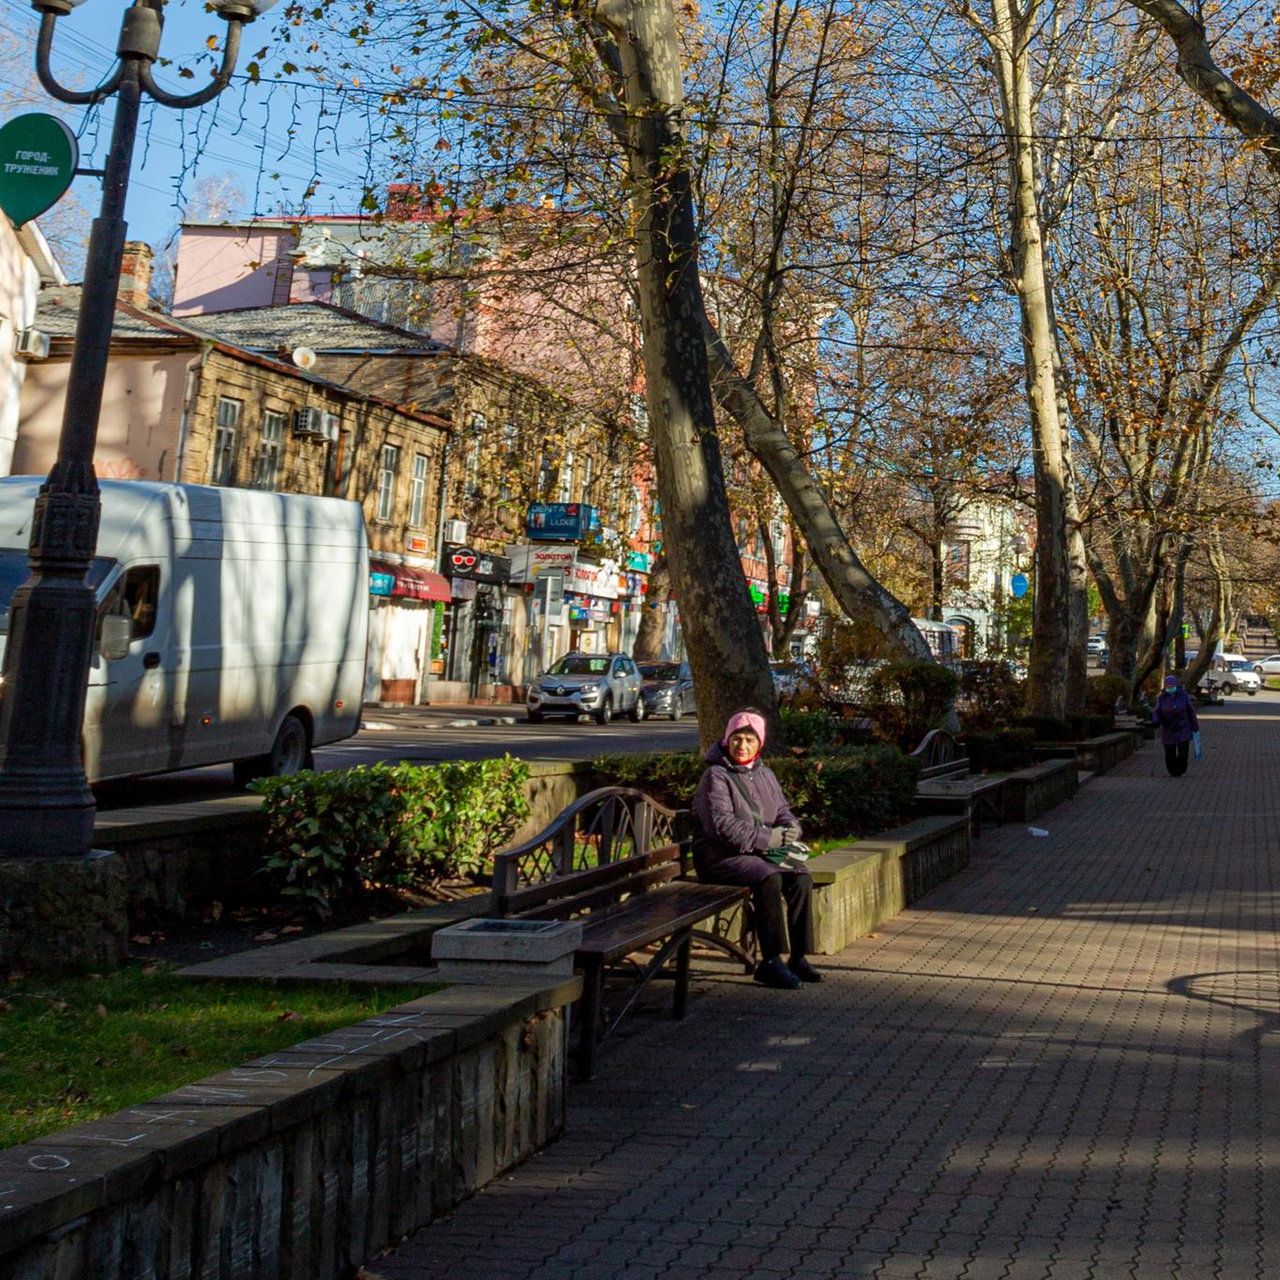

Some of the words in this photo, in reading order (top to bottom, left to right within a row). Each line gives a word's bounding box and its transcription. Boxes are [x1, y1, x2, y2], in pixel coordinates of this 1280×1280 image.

[15, 150, 52, 163] ГОРОД-
[4, 163, 59, 176] ТРУЖЕНИК
[550, 518, 576, 526] LUXE
